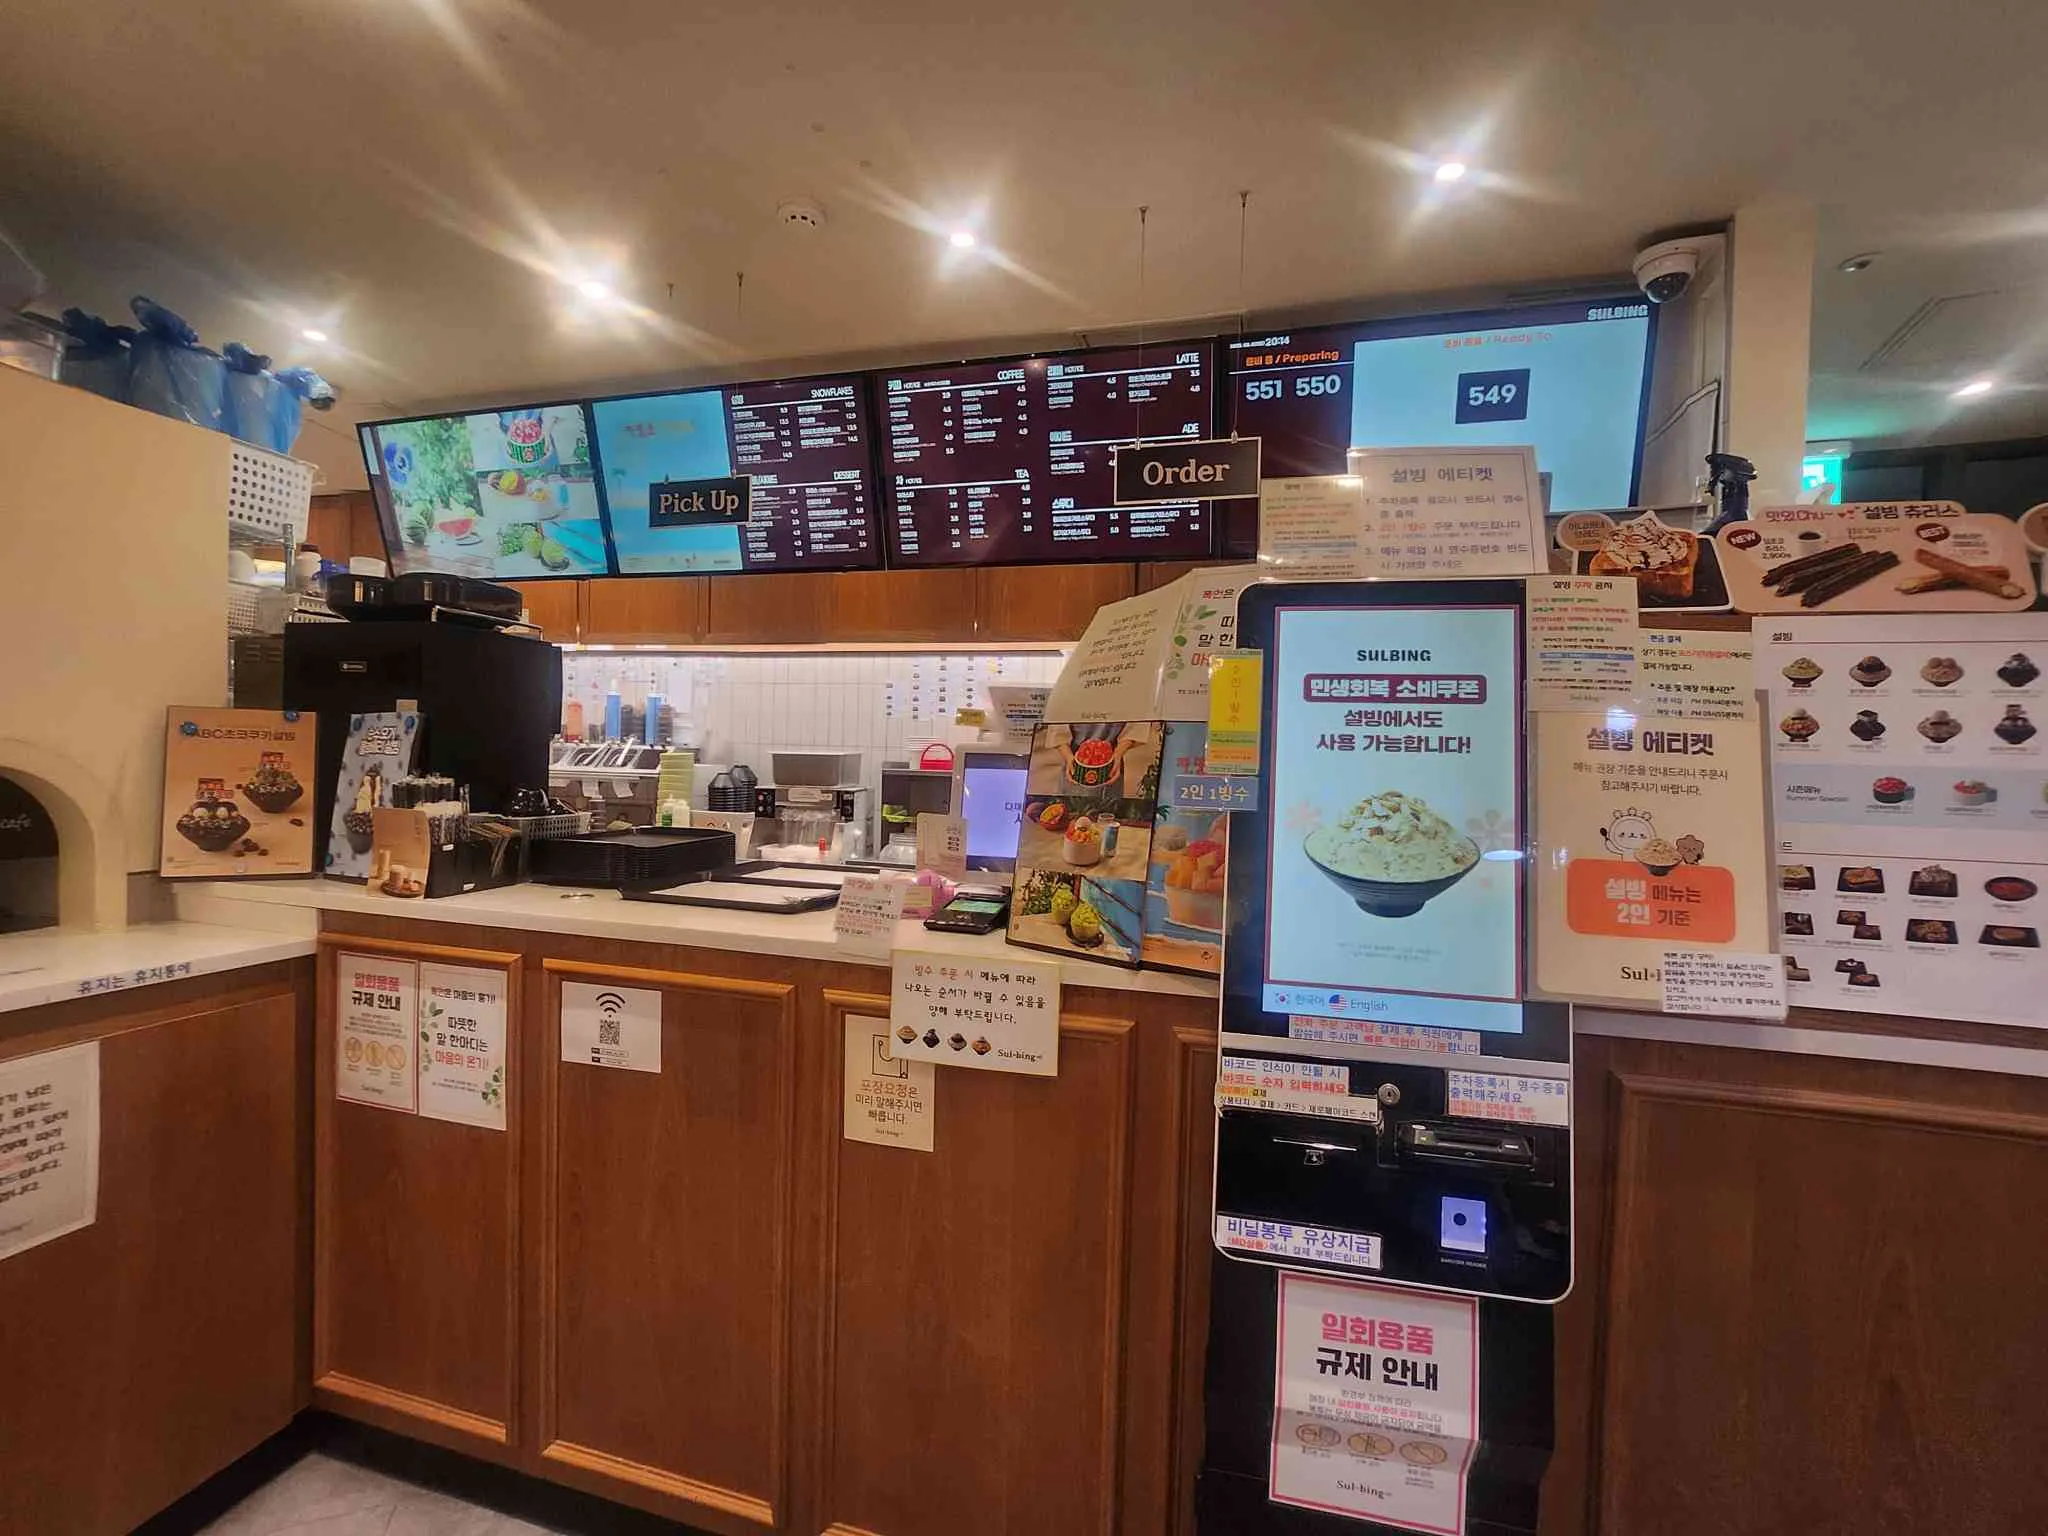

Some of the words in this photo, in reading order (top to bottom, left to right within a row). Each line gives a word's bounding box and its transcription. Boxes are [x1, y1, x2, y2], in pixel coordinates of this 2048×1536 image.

[1587, 304, 1648, 320] SULBING
[1176, 352, 1199, 364] LATTE
[1283, 351, 1340, 363] Preparing
[997, 369, 1025, 380] COFFEE
[810, 386, 854, 399] SNOWFLAKES
[1245, 380, 1282, 400] 551
[1295, 374, 1341, 397] 550
[1468, 384, 1516, 406] 549
[1182, 423, 1199, 434] ADE
[1014, 469, 1029, 479] TEA
[1143, 458, 1231, 486] Order
[1391, 468, 1427, 484] 설빙
[1438, 466, 1494, 483] 에티켓
[659, 494, 706, 515] Pick
[710, 490, 740, 516] Up
[1904, 503, 1961, 519] 츄러스
[1730, 532, 1756, 545] NEW
[1357, 649, 1432, 662] SULBING
[1310, 678, 1390, 698] 민생회복
[1396, 679, 1480, 700] 소비쿠폰
[1344, 709, 1443, 728] 설빙에서도
[1316, 734, 1356, 752] 사용
[1362, 735, 1471, 754] 가능합니다!
[1642, 730, 1714, 756] 에티켓
[1180, 784, 1204, 800] 2인
[1208, 785, 1250, 803] 1빙수
[1601, 780, 1658, 795] 참고해주시기
[1660, 783, 1702, 797] 바랍니다.
[1605, 878, 1647, 901] 설빙
[1652, 884, 1702, 905] 메뉴는
[1616, 904, 1651, 925] 2인
[1657, 909, 1691, 927] 기준
[78, 975, 126, 994] 휴지는
[134, 961, 192, 984] 휴지통에
[914, 965, 934, 977] 빙수
[940, 967, 959, 980] 주문
[965, 969, 974, 980] 시
[979, 970, 1011, 984] 메뉴에
[1015, 974, 1037, 986] 따라
[351, 990, 375, 1008] 규제
[377, 993, 401, 1012] 안내
[904, 982, 933, 998] 나오는
[937, 986, 968, 1000] 순서가
[999, 993, 1009, 1003] 수
[1015, 994, 1047, 1010] 있음을
[1350, 998, 1389, 1014] English
[447, 1016, 478, 1033] 따뜻한
[928, 1004, 949, 1018] 양해
[953, 1007, 1017, 1026] 부탁드립니다.
[436, 1032, 448, 1046] 말
[449, 1034, 490, 1053] 한마디는
[1328, 1031, 1359, 1044] 주시면
[435, 1050, 466, 1066] 마음의
[1223, 1058, 1257, 1070] 바코드
[1262, 1061, 1296, 1074] 인식이
[1329, 1067, 1341, 1080] 시
[1222, 1072, 1257, 1085] 바코드
[1289, 1079, 1347, 1096] 입력하세요
[855, 1093, 873, 1108] 미리
[875, 1095, 923, 1114] 말해주시면
[1283, 1103, 1300, 1112] 카드
[867, 1109, 908, 1126] 빠릅니다.
[1227, 1218, 1294, 1243] 비닐봉투
[1302, 1228, 1373, 1254] 유상지급
[1292, 1244, 1311, 1257] 결제
[1315, 1247, 1372, 1266] 부탁드립니다
[1321, 1312, 1434, 1356] 일회용품
[1316, 1347, 1372, 1381] 규제
[1382, 1357, 1439, 1391] 안내
